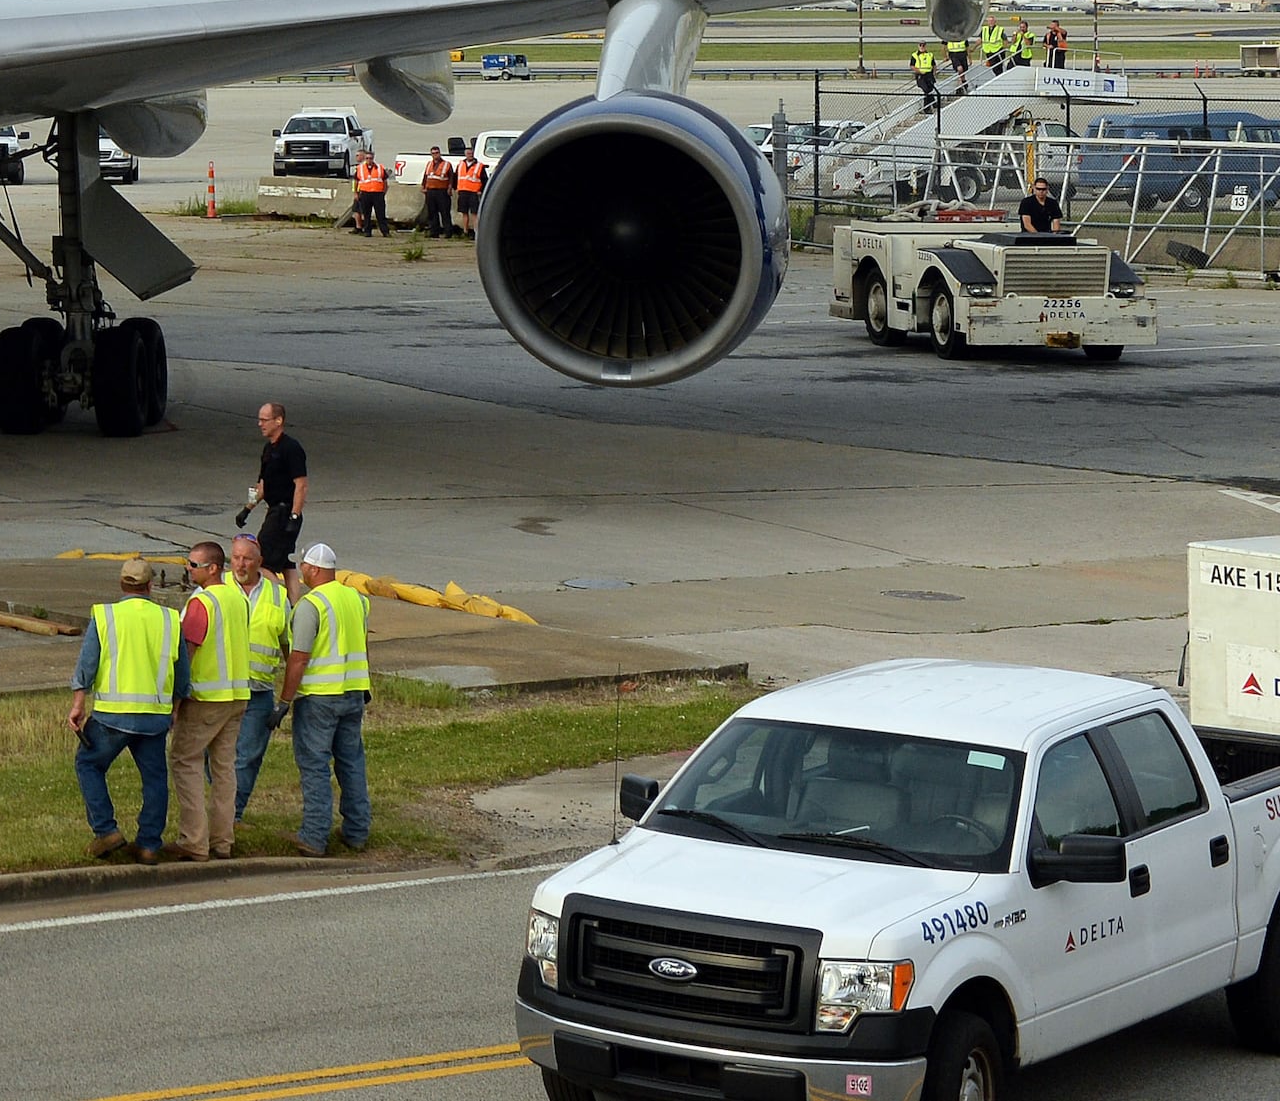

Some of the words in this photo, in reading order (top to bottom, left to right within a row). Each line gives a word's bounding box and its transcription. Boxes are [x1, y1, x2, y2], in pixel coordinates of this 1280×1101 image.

[1043, 76, 1090, 87] UNITED
[1235, 197, 1245, 207] 13
[862, 238, 883, 249] DELTA
[918, 251, 932, 261] 22256
[1043, 299, 1081, 308] 22256
[1049, 311, 1086, 319] DELTA
[1211, 564, 1247, 588] AKE
[921, 900, 989, 945] 491480
[1079, 915, 1125, 946] DELTA
